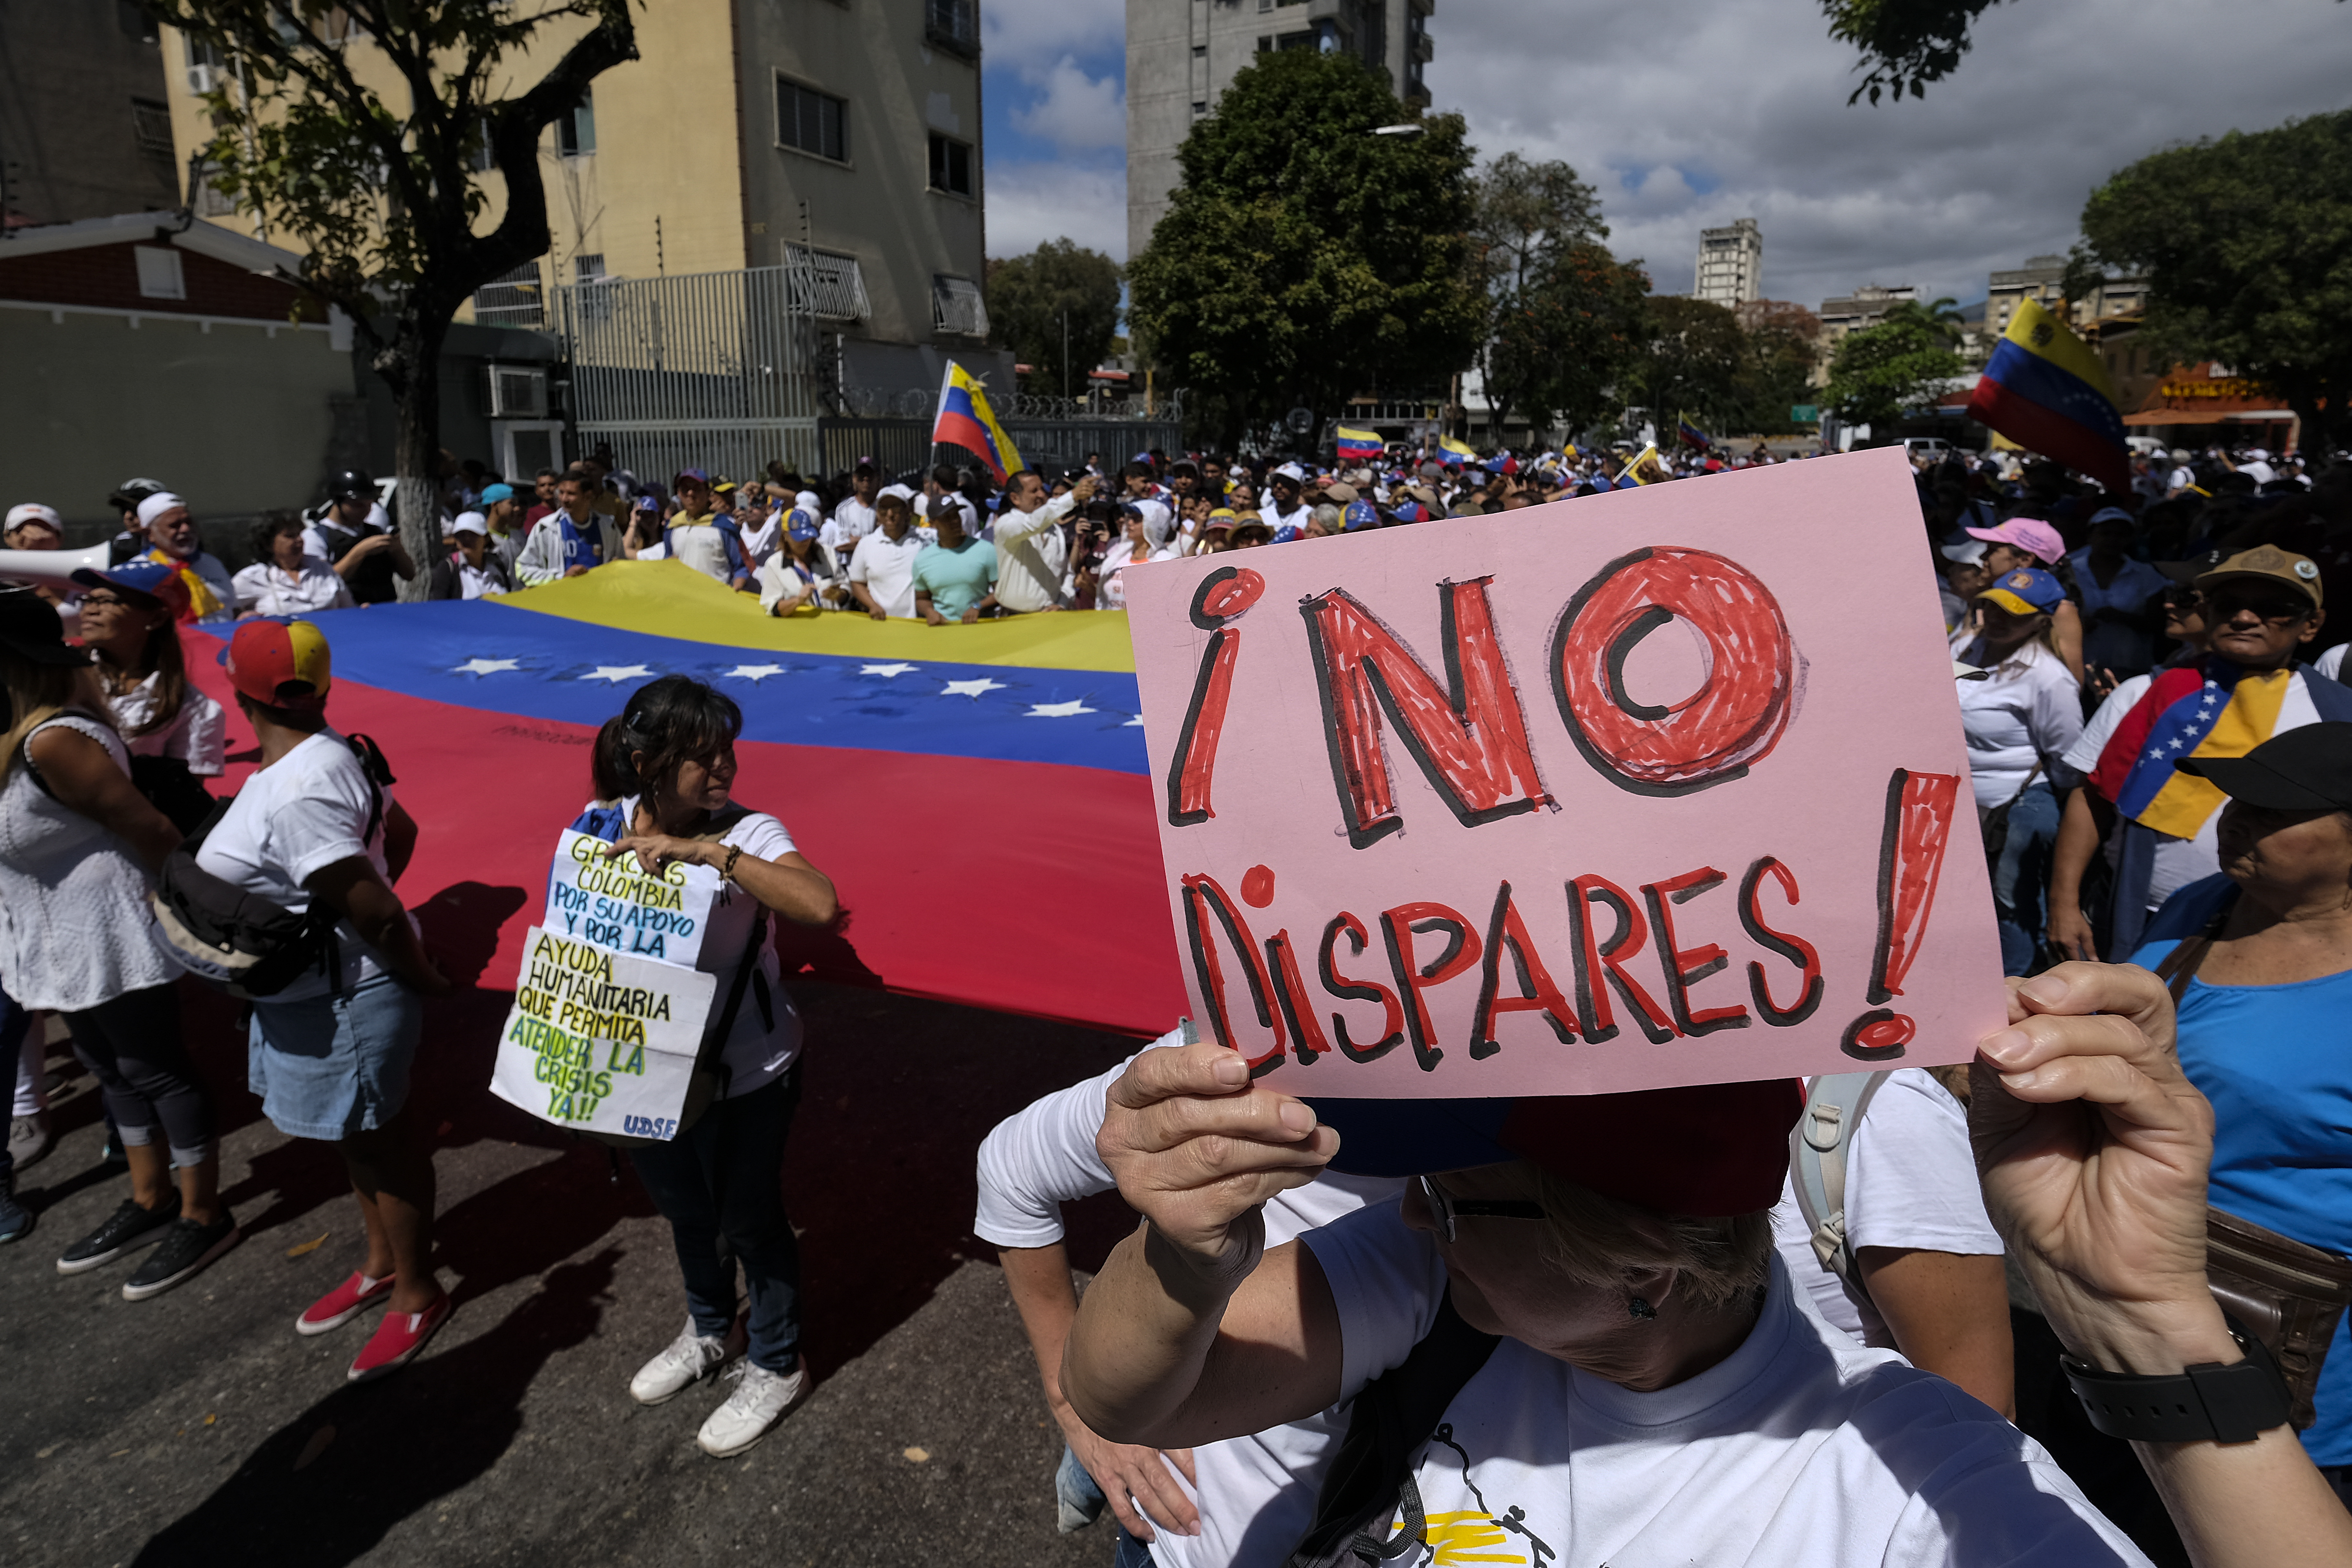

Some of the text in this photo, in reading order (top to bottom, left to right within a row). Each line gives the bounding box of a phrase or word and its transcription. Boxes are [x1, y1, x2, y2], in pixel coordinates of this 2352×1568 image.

[1168, 545, 1803, 849] ¡NO
[572, 835, 686, 886] GRACS
[555, 881, 695, 937] POR SU APOYO
[578, 866, 682, 911] COLOMBIA
[534, 934, 611, 982] AYUDA
[565, 912, 663, 958] Y POR LA
[519, 986, 645, 1045] QUE PERMITA
[529, 961, 670, 1021] HUMANITARIA
[509, 1015, 644, 1076] ATENDER LA
[535, 1056, 612, 1098] CRISIS
[548, 1088, 598, 1121] YA!!
[624, 1115, 676, 1138] UDSE
